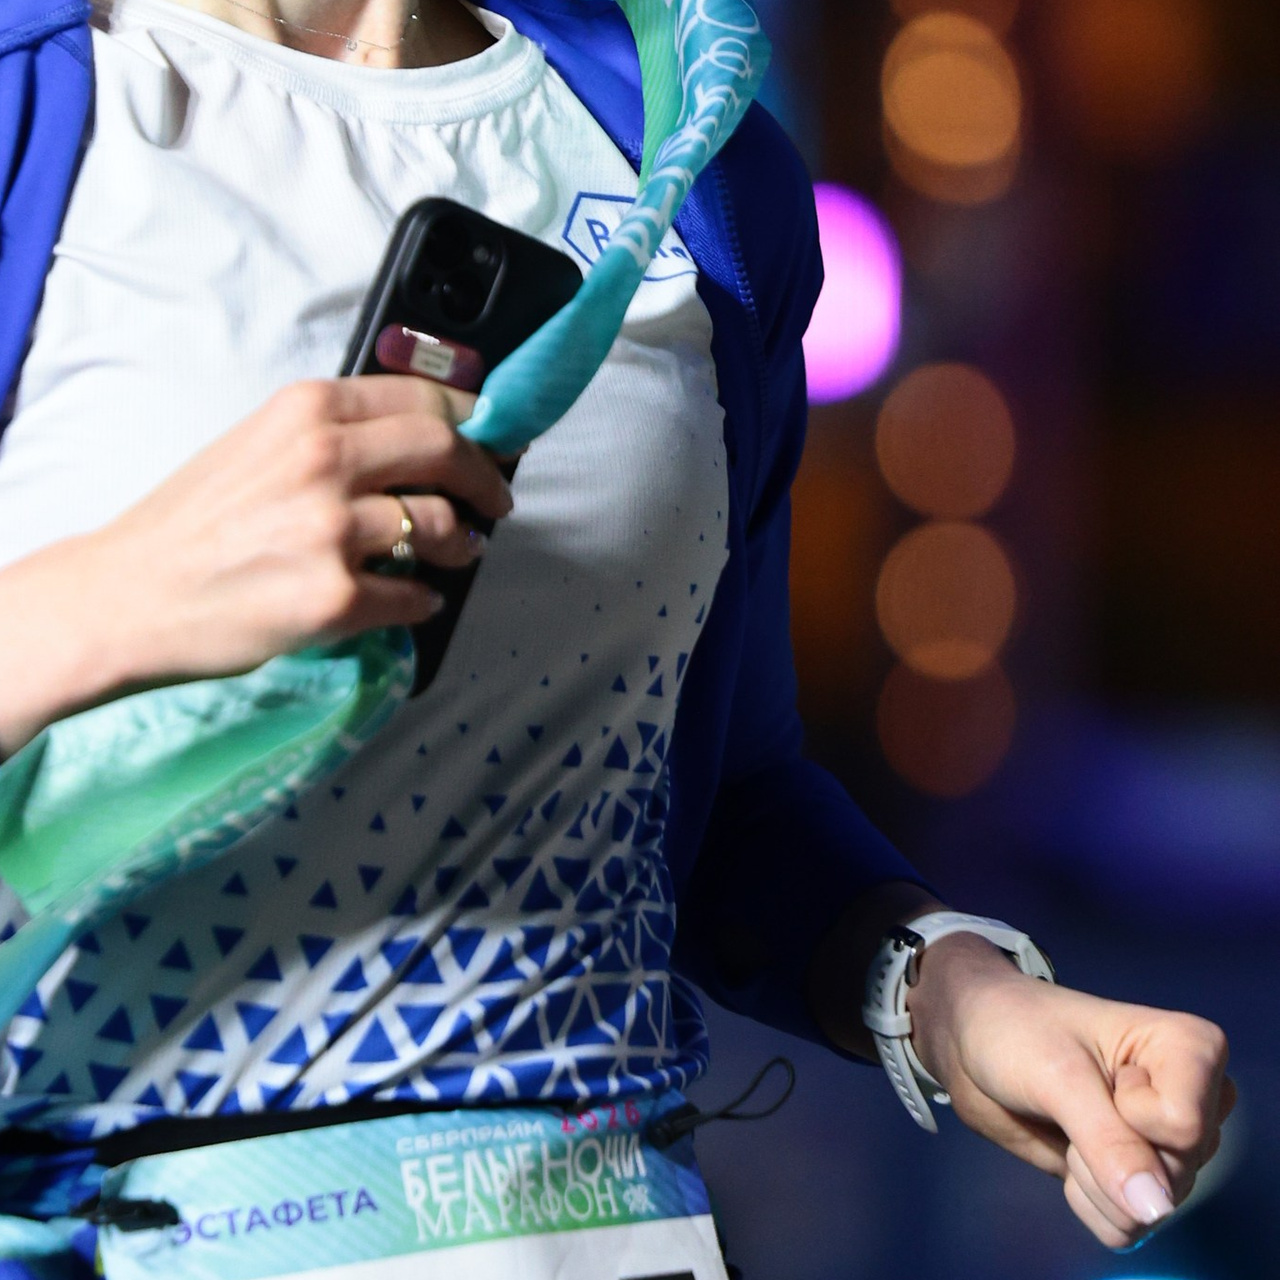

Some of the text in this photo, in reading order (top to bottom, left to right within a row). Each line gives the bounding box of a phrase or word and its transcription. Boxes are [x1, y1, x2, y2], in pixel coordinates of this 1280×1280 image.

[396, 1119, 544, 1155] СБЕРПРАЙМ
[541, 1133, 647, 1188] НОЧИ
[171, 1186, 379, 1247] ЭСТАФЕТА
[416, 1177, 620, 1243] МАРАФОН
